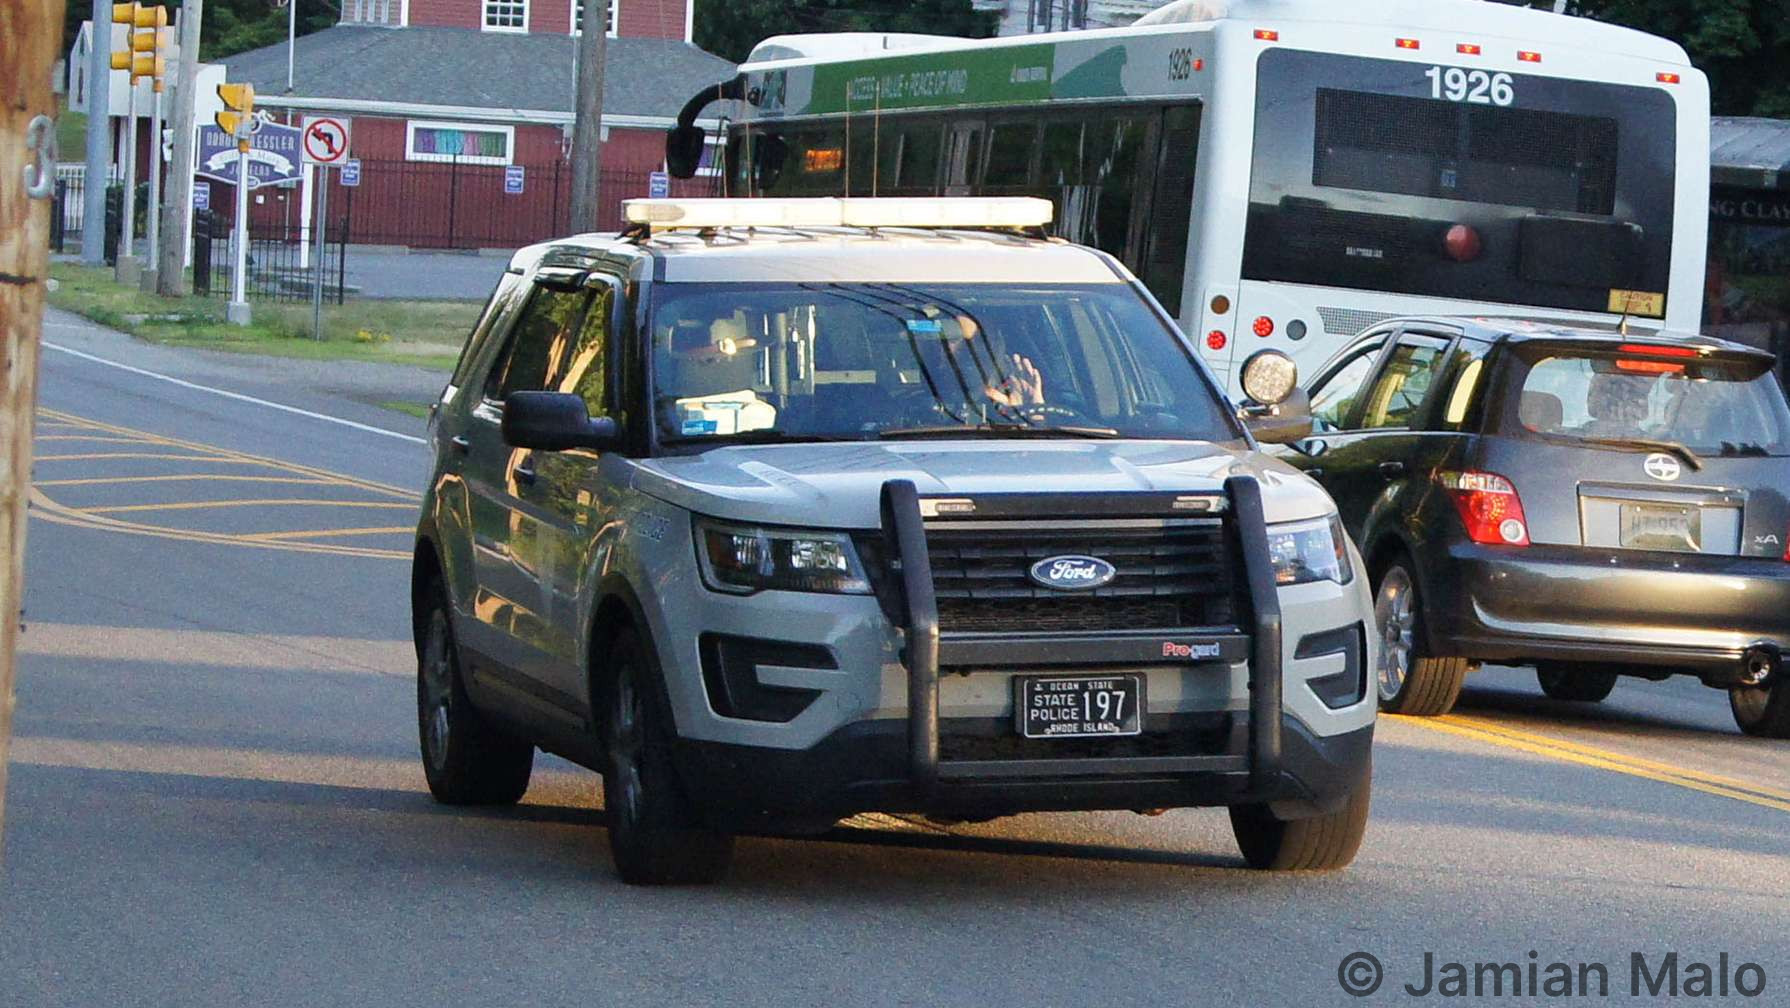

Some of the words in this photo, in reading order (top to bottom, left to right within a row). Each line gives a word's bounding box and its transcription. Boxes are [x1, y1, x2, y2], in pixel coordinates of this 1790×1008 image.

[1168, 47, 1193, 81] 1926
[1425, 66, 1514, 107] 1926
[1049, 560, 1097, 580] Ford
[1050, 681, 1079, 691] OCEAN
[1087, 680, 1113, 690] STATE
[1034, 694, 1076, 706] STATE
[1083, 691, 1126, 721] 197
[1030, 708, 1079, 721] POLICE
[1050, 723, 1078, 733] RHODE
[1083, 722, 1114, 732] ISLAND
